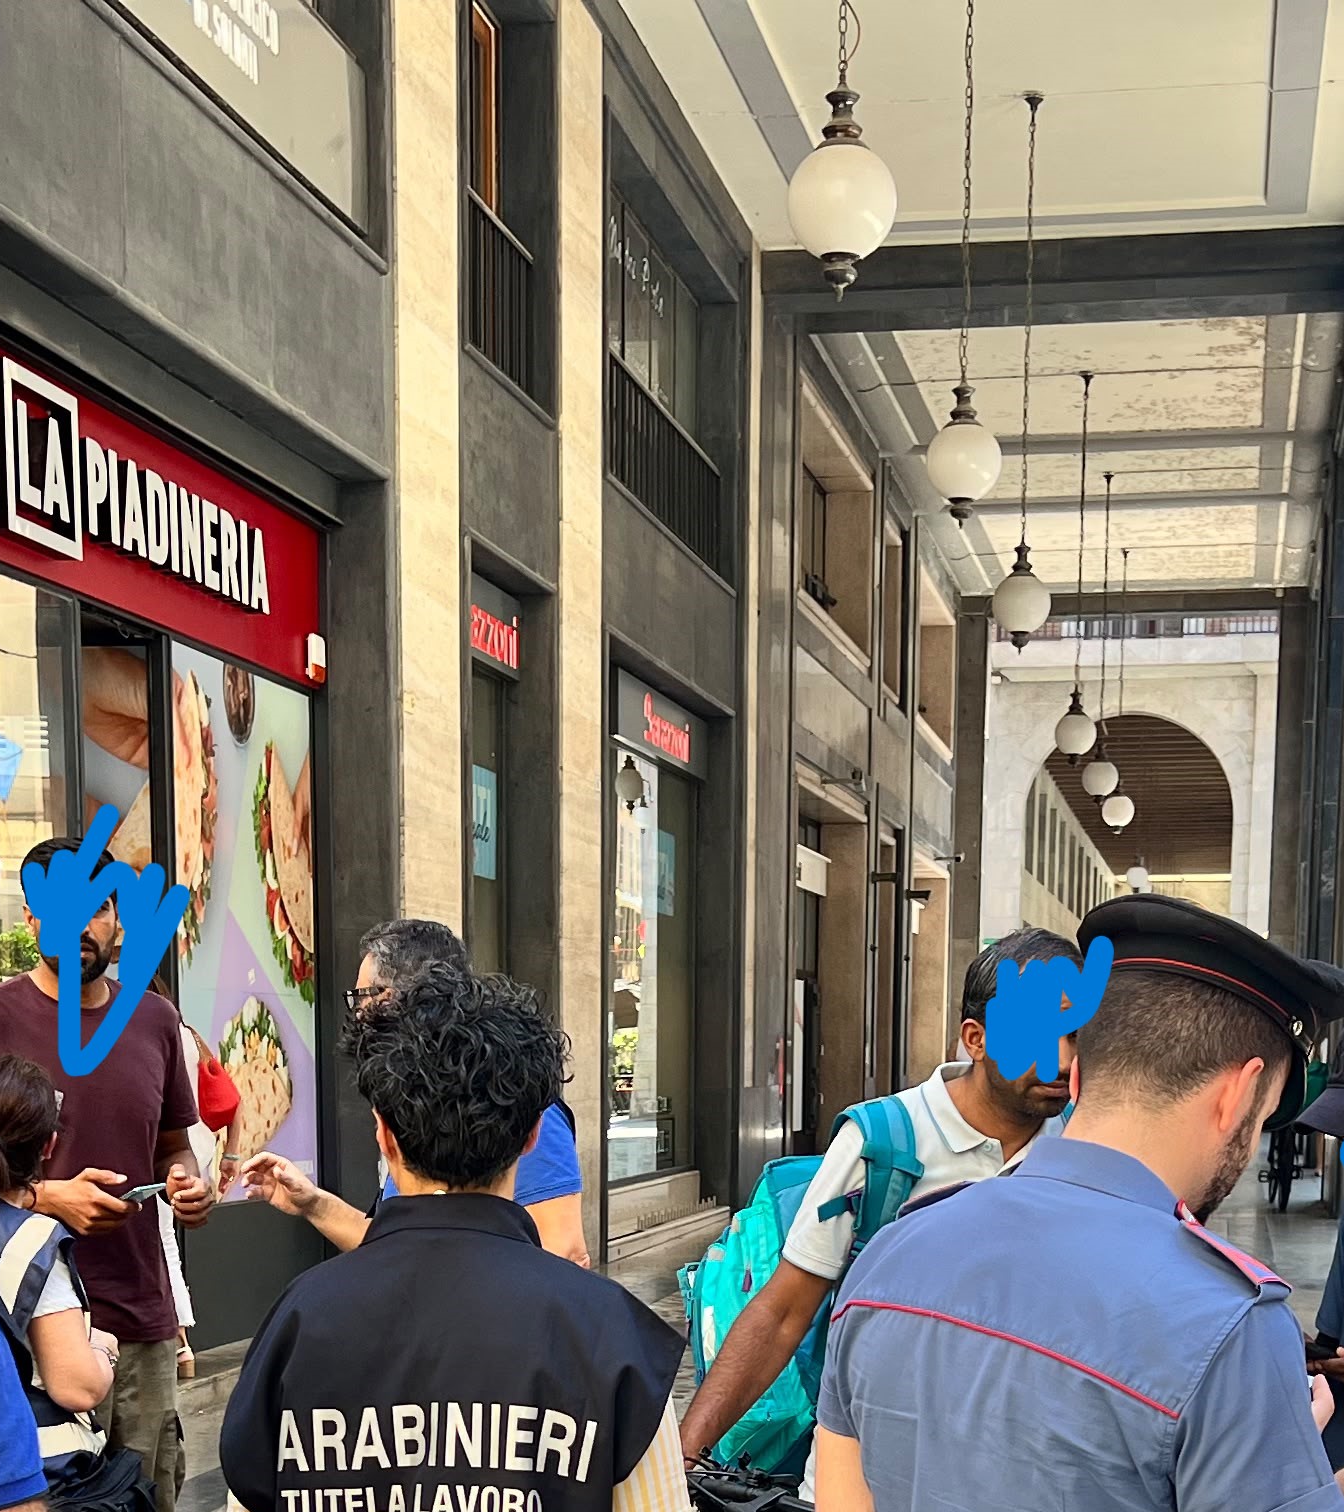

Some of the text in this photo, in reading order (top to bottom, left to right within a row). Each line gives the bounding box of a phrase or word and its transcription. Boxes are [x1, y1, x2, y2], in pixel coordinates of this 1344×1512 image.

[17, 398, 71, 523] LA
[86, 436, 270, 615] PIADINERIA
[471, 604, 520, 670] azzoni
[277, 1401, 598, 1483] ARABINIERI
